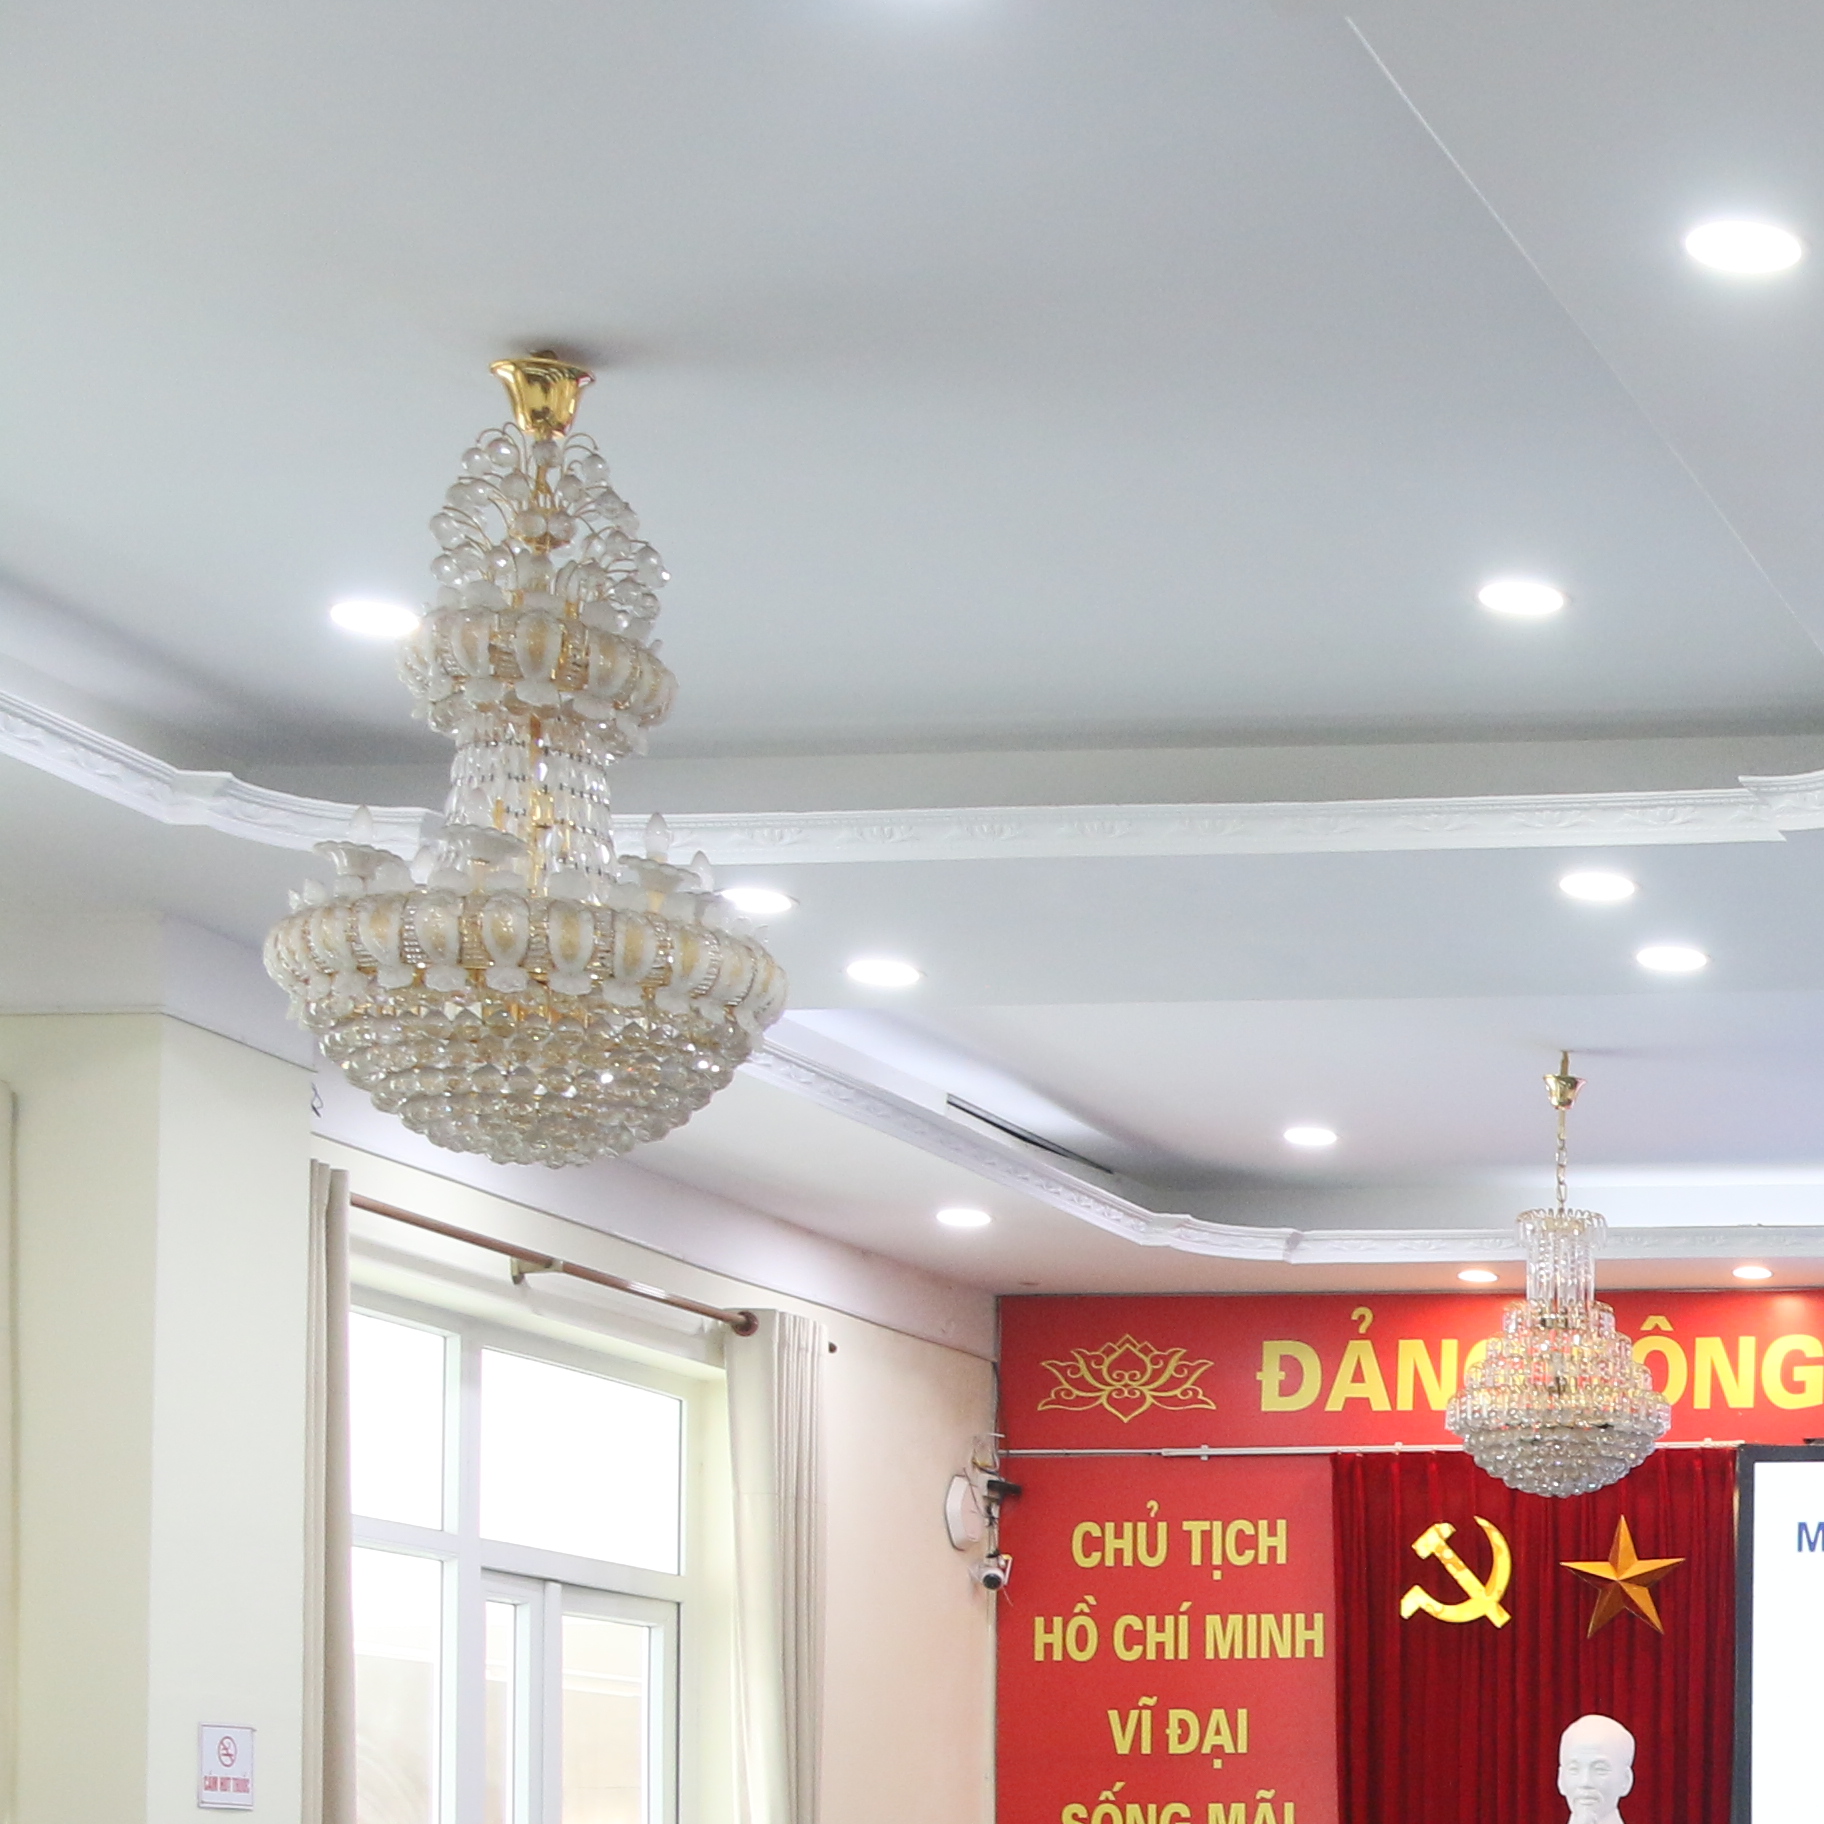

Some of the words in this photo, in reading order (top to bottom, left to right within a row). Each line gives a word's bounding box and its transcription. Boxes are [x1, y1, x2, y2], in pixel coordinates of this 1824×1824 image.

[1256, 1307, 1505, 1411] ĐẢN
[1072, 1501, 1167, 1568] CHỦ
[1182, 1519, 1287, 1579] TỊCH
[1034, 1596, 1098, 1661] HỒ
[1113, 1602, 1191, 1660] CHÍ
[1205, 1613, 1324, 1659] MINH
[1108, 1697, 1157, 1754] VĨ
[1166, 1709, 1248, 1768] ĐẠI
